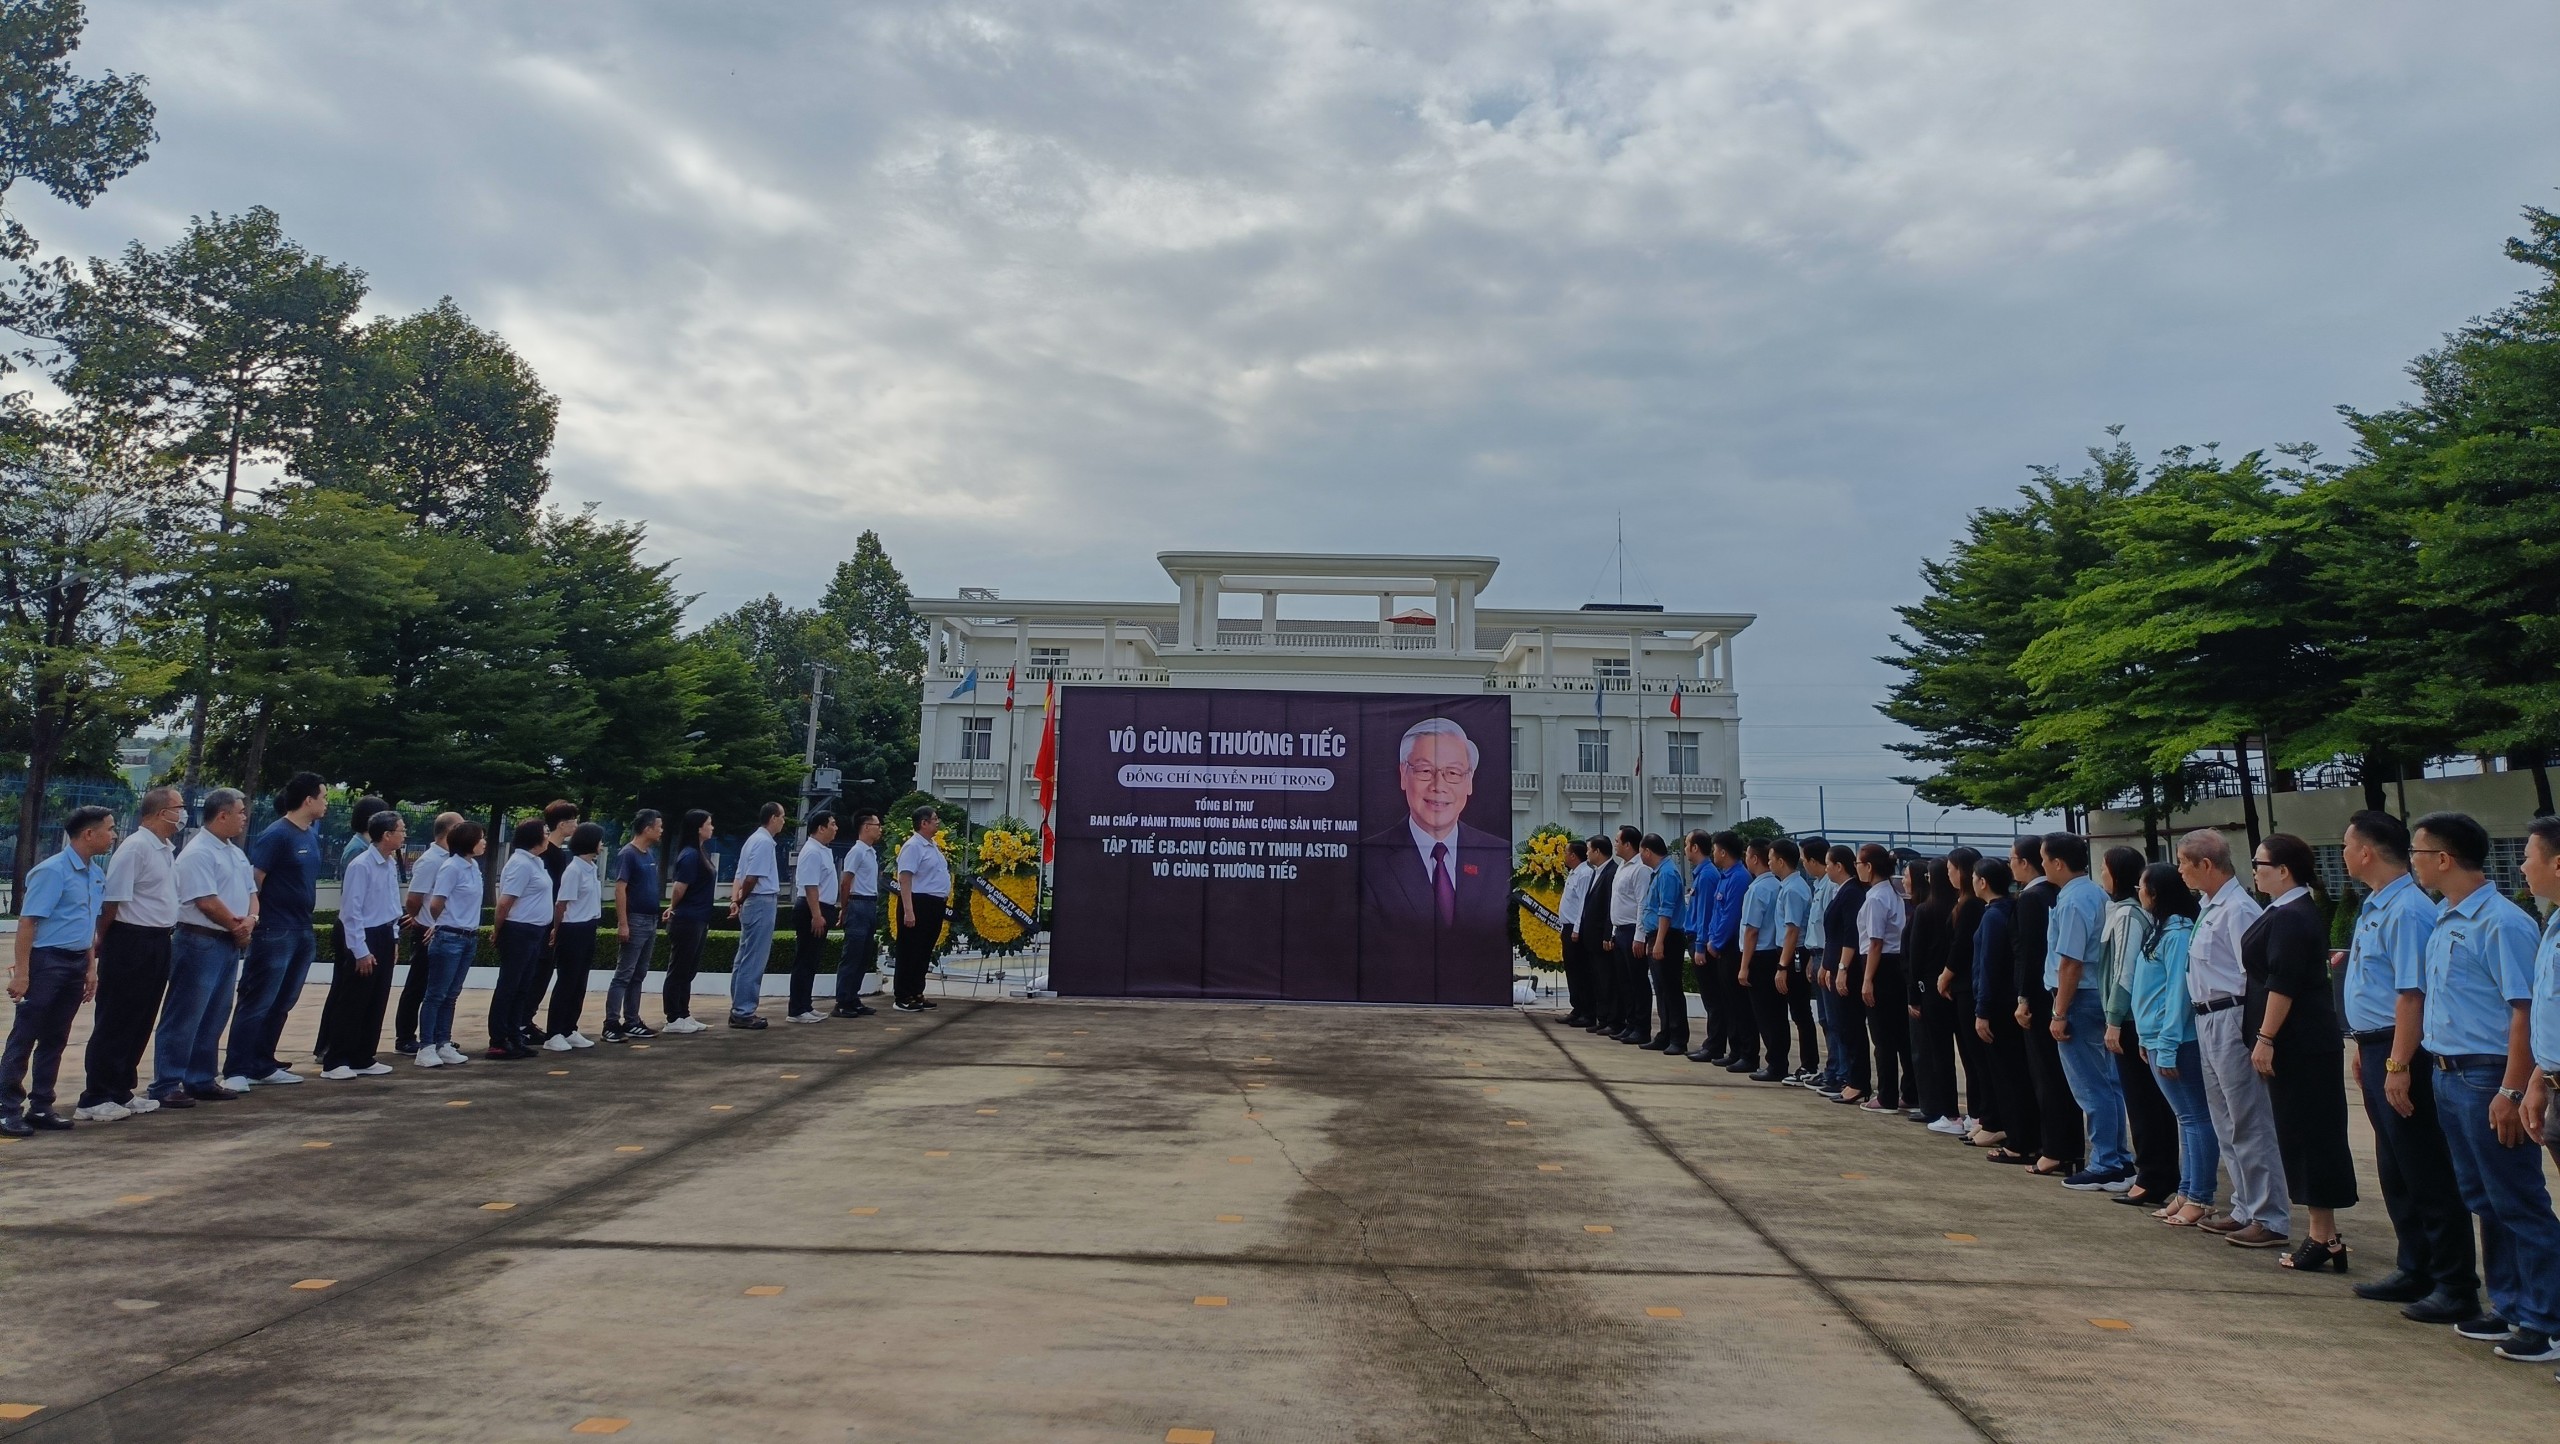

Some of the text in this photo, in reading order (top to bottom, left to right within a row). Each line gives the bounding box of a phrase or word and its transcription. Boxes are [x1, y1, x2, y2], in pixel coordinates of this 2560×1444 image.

[1109, 725, 1346, 757] VÔ CÙNG THƯƠNG TIẾC
[1126, 767, 1326, 788] ĐỒNG CHÍ NGUYỄN PHÚ TRỌNG
[1222, 798, 1233, 812] BÍ
[1235, 800, 1254, 812] THƯ
[1090, 812, 1358, 833] BAN CHẤP HÀNH TRUNG ƯƠNG ĐẢNG CỘNG SẢN VIỆT NAM
[1102, 835, 1127, 857] TẬP
[1131, 832, 1156, 854] THỂ
[1210, 837, 1246, 856] CÔNG
[1249, 841, 1265, 856] TY
[1268, 842, 1302, 857] TNHH
[1305, 842, 1348, 858] ASTRO
[1152, 858, 1298, 880] VÔ CÙNG THƯƠNG TIẾC
[1007, 900, 1016, 910] TY
[1014, 908, 1033, 925] ASTRO
